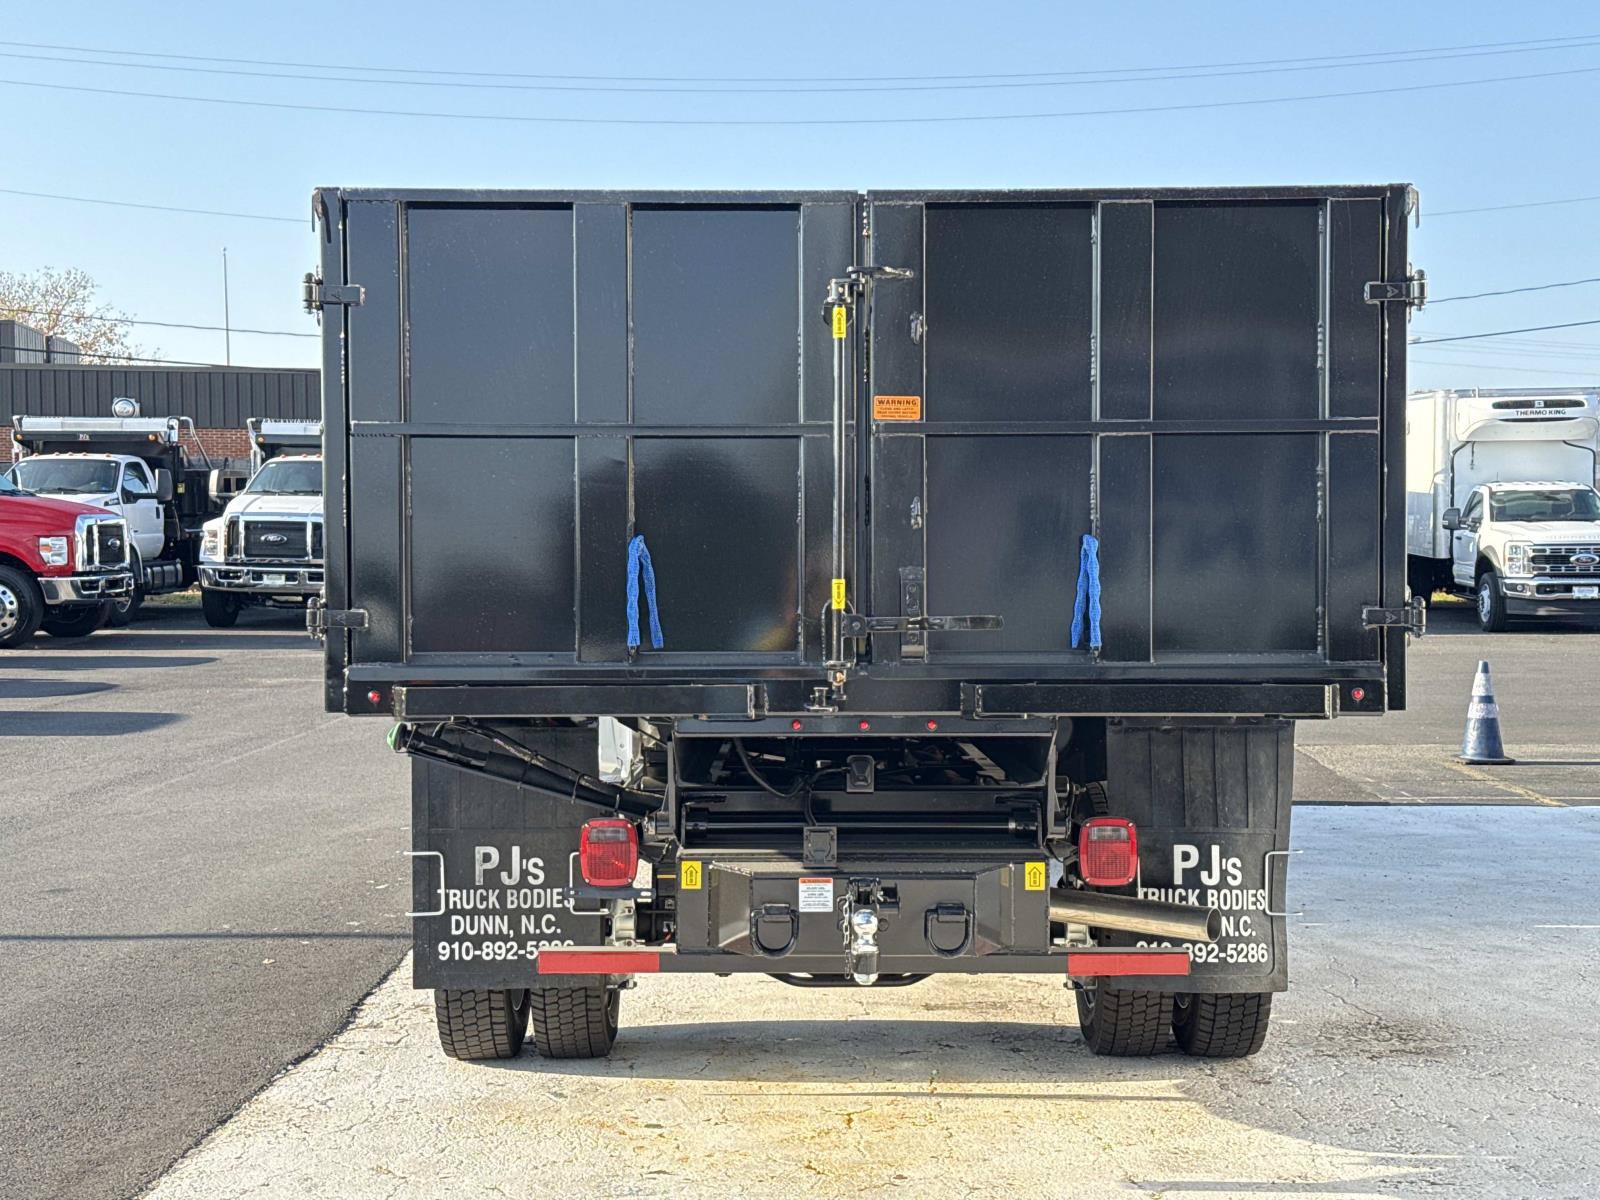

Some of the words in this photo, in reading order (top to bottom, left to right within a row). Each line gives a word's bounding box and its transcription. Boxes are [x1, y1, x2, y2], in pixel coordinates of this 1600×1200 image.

[450, 914, 514, 938] DUNN,
[521, 914, 562, 935] N.C.
[1221, 915, 1257, 937] N.C.
[437, 939, 575, 961] 910-892-5
